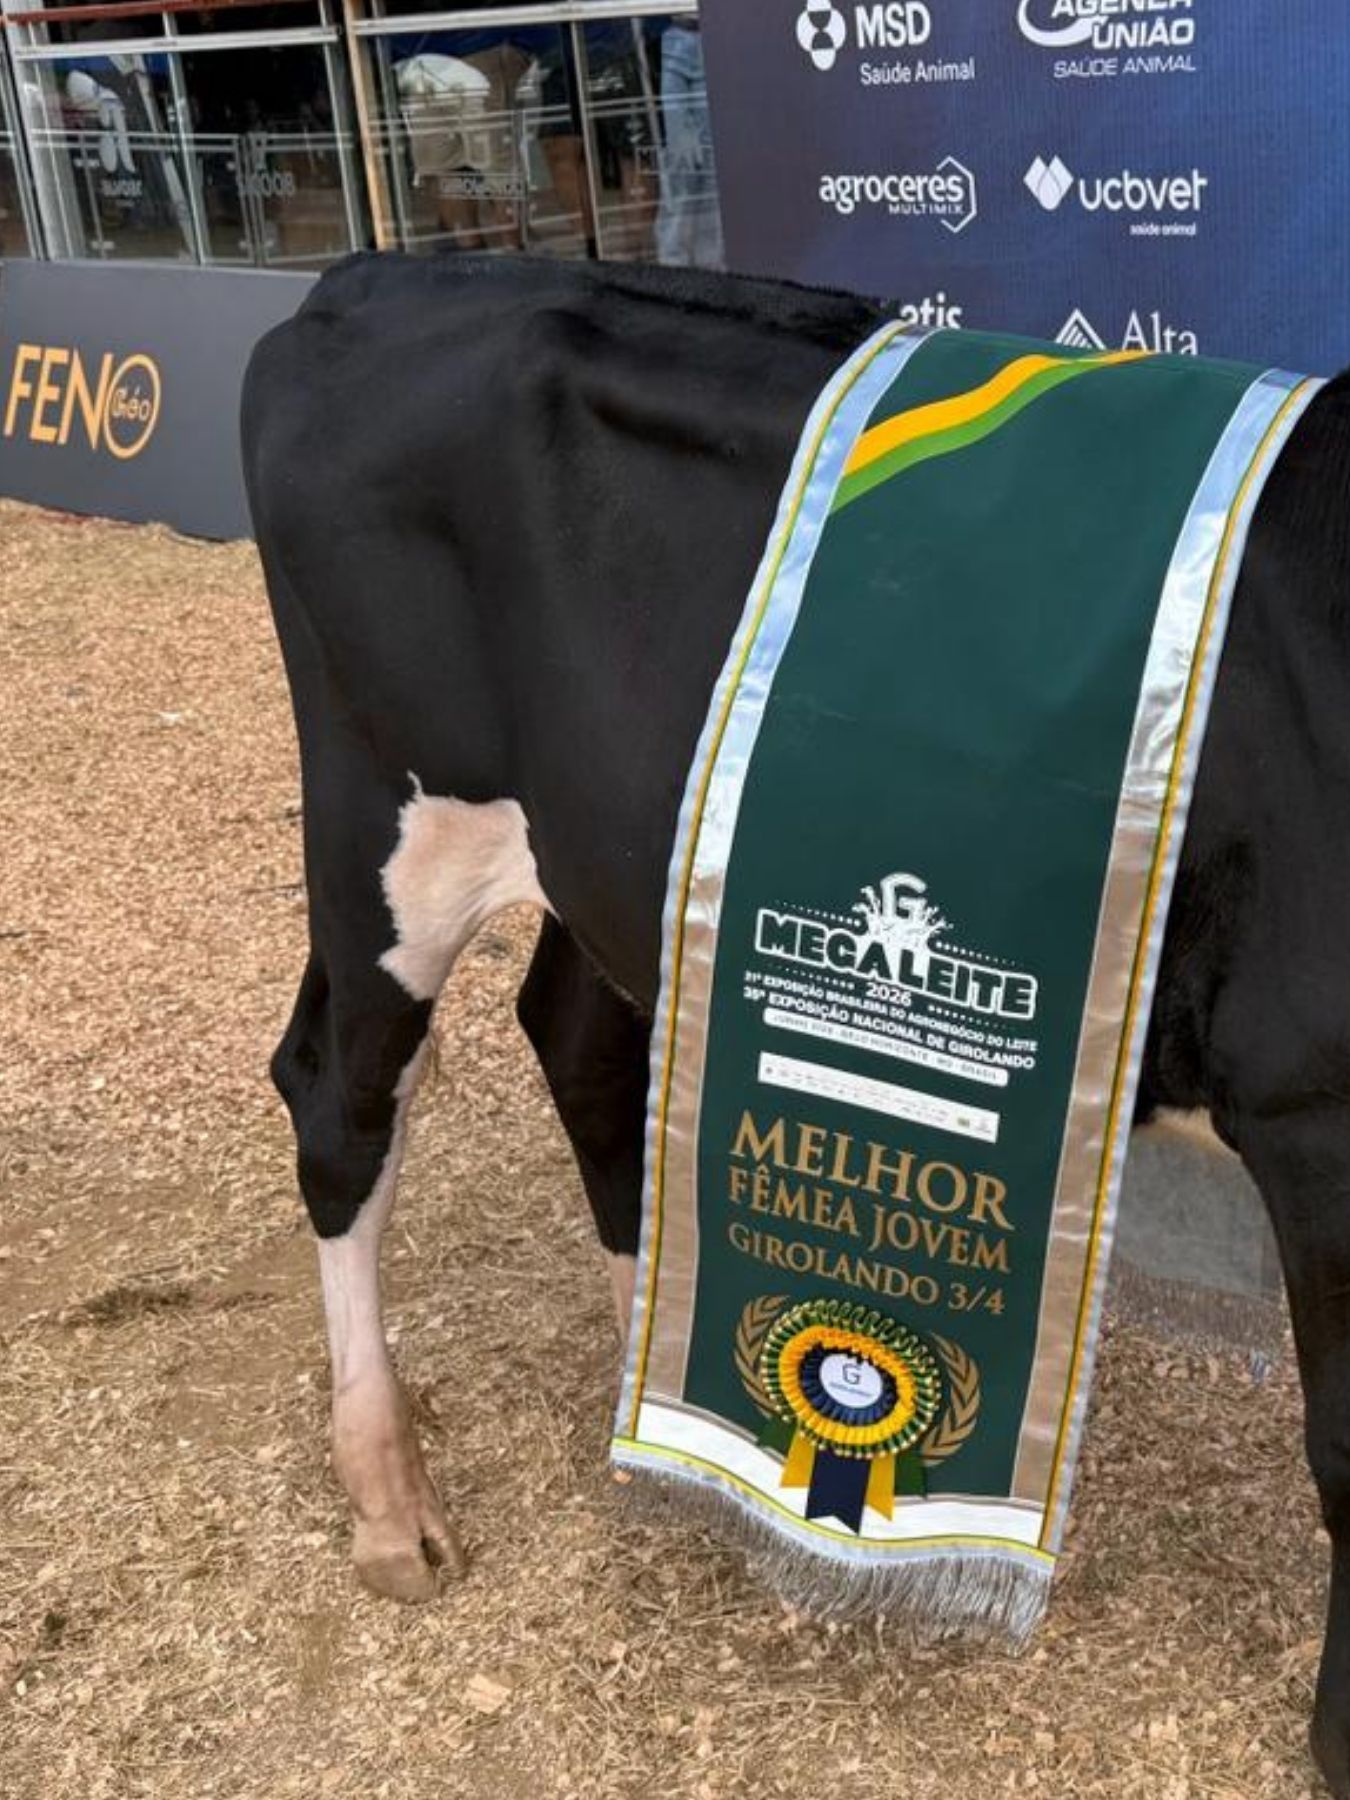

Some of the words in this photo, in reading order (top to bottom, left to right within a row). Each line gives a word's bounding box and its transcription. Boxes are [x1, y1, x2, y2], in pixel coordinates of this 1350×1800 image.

[855, 1, 931, 48] MSD
[1092, 17, 1195, 49] UNIÃO
[860, 61, 911, 86] Saúde
[915, 56, 976, 82] Animal
[1053, 56, 1118, 78] SAÚDE
[1122, 55, 1196, 74] ANIMAL
[819, 175, 965, 214] agroceres
[889, 203, 964, 215] MULTIMIX
[1079, 168, 1208, 211] ucbvet
[1161, 222, 1197, 236] animal
[899, 290, 963, 329] atis
[1120, 309, 1199, 356] Alta
[4, 343, 161, 459] FENO
[755, 907, 1039, 1020] MEGALEITE
[865, 981, 912, 1007] 2026
[768, 991, 850, 1023] EXPOSIÇÃO
[852, 1012, 924, 1044] NACIONAL
[926, 1033, 946, 1051] DE
[948, 1039, 1036, 1071] GIROLANDO
[730, 1109, 1015, 1231] MELHOR
[728, 1164, 860, 1238] FÊMEA
[868, 1205, 1012, 1275] JOVEM
[728, 1221, 940, 1306] GIROLANDO
[949, 1281, 1006, 1316] 3/4
